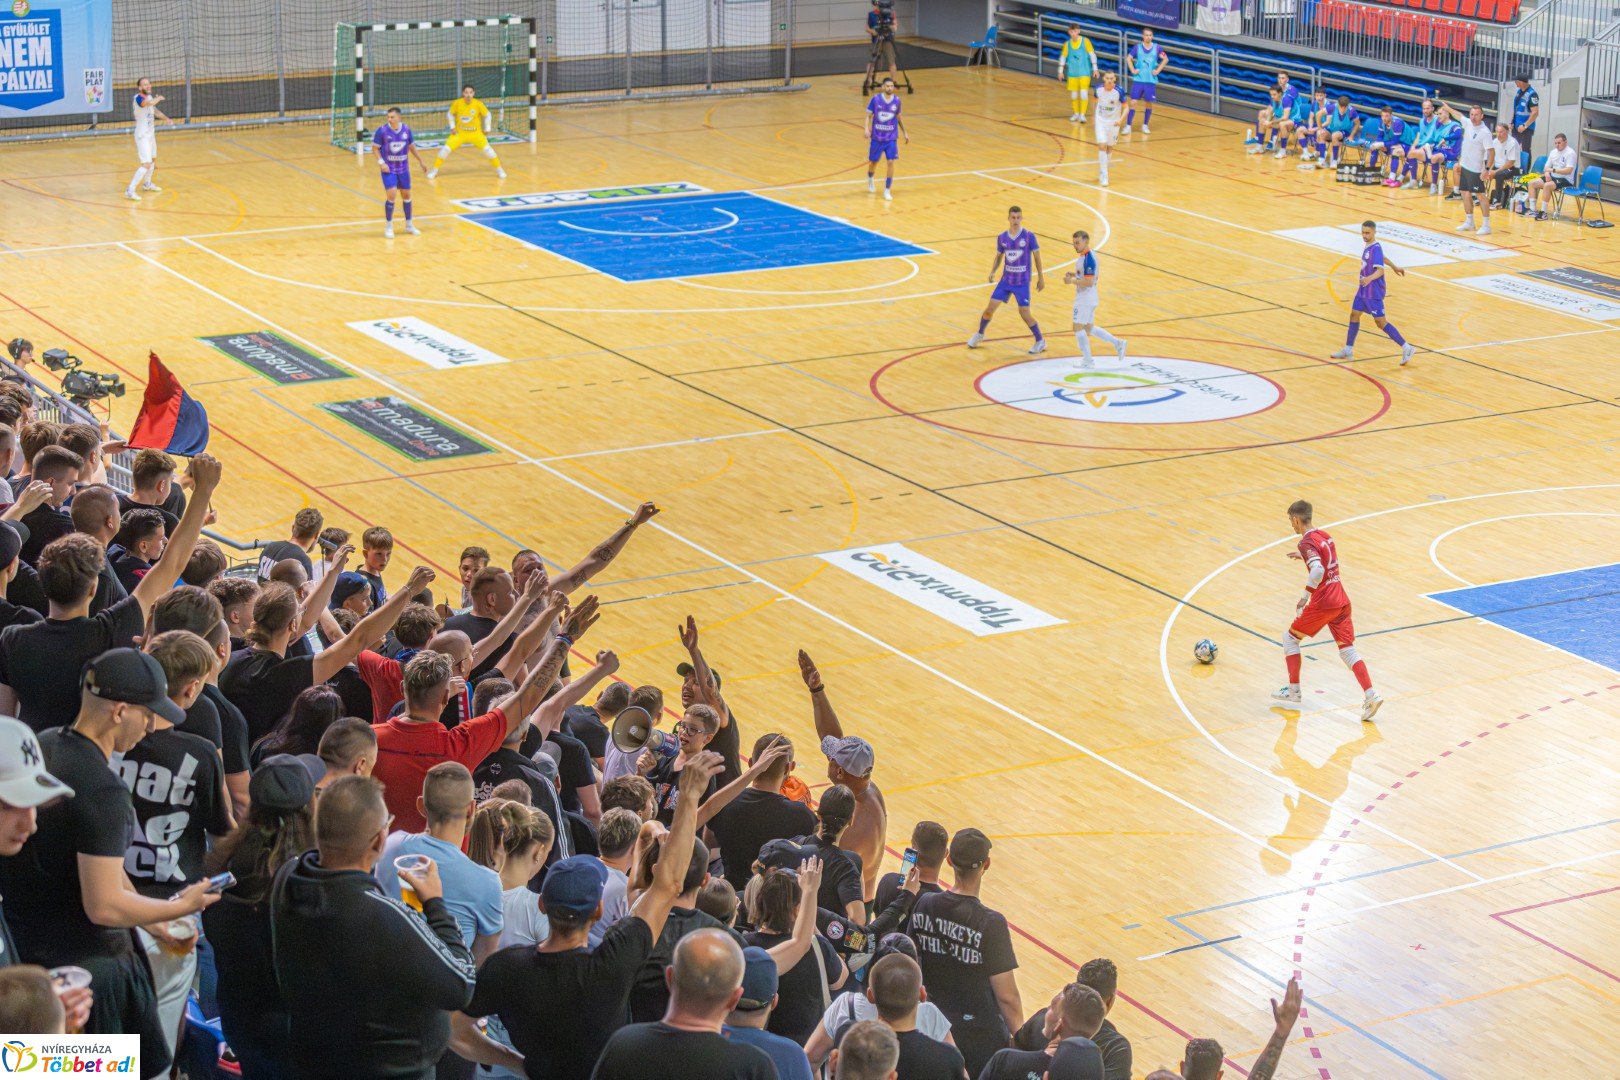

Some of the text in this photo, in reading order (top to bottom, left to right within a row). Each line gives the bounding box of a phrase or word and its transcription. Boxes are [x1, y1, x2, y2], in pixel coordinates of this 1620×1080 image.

[0, 36, 52, 68] NEM
[85, 71, 104, 79] FAIR
[85, 79, 103, 87] PLAY
